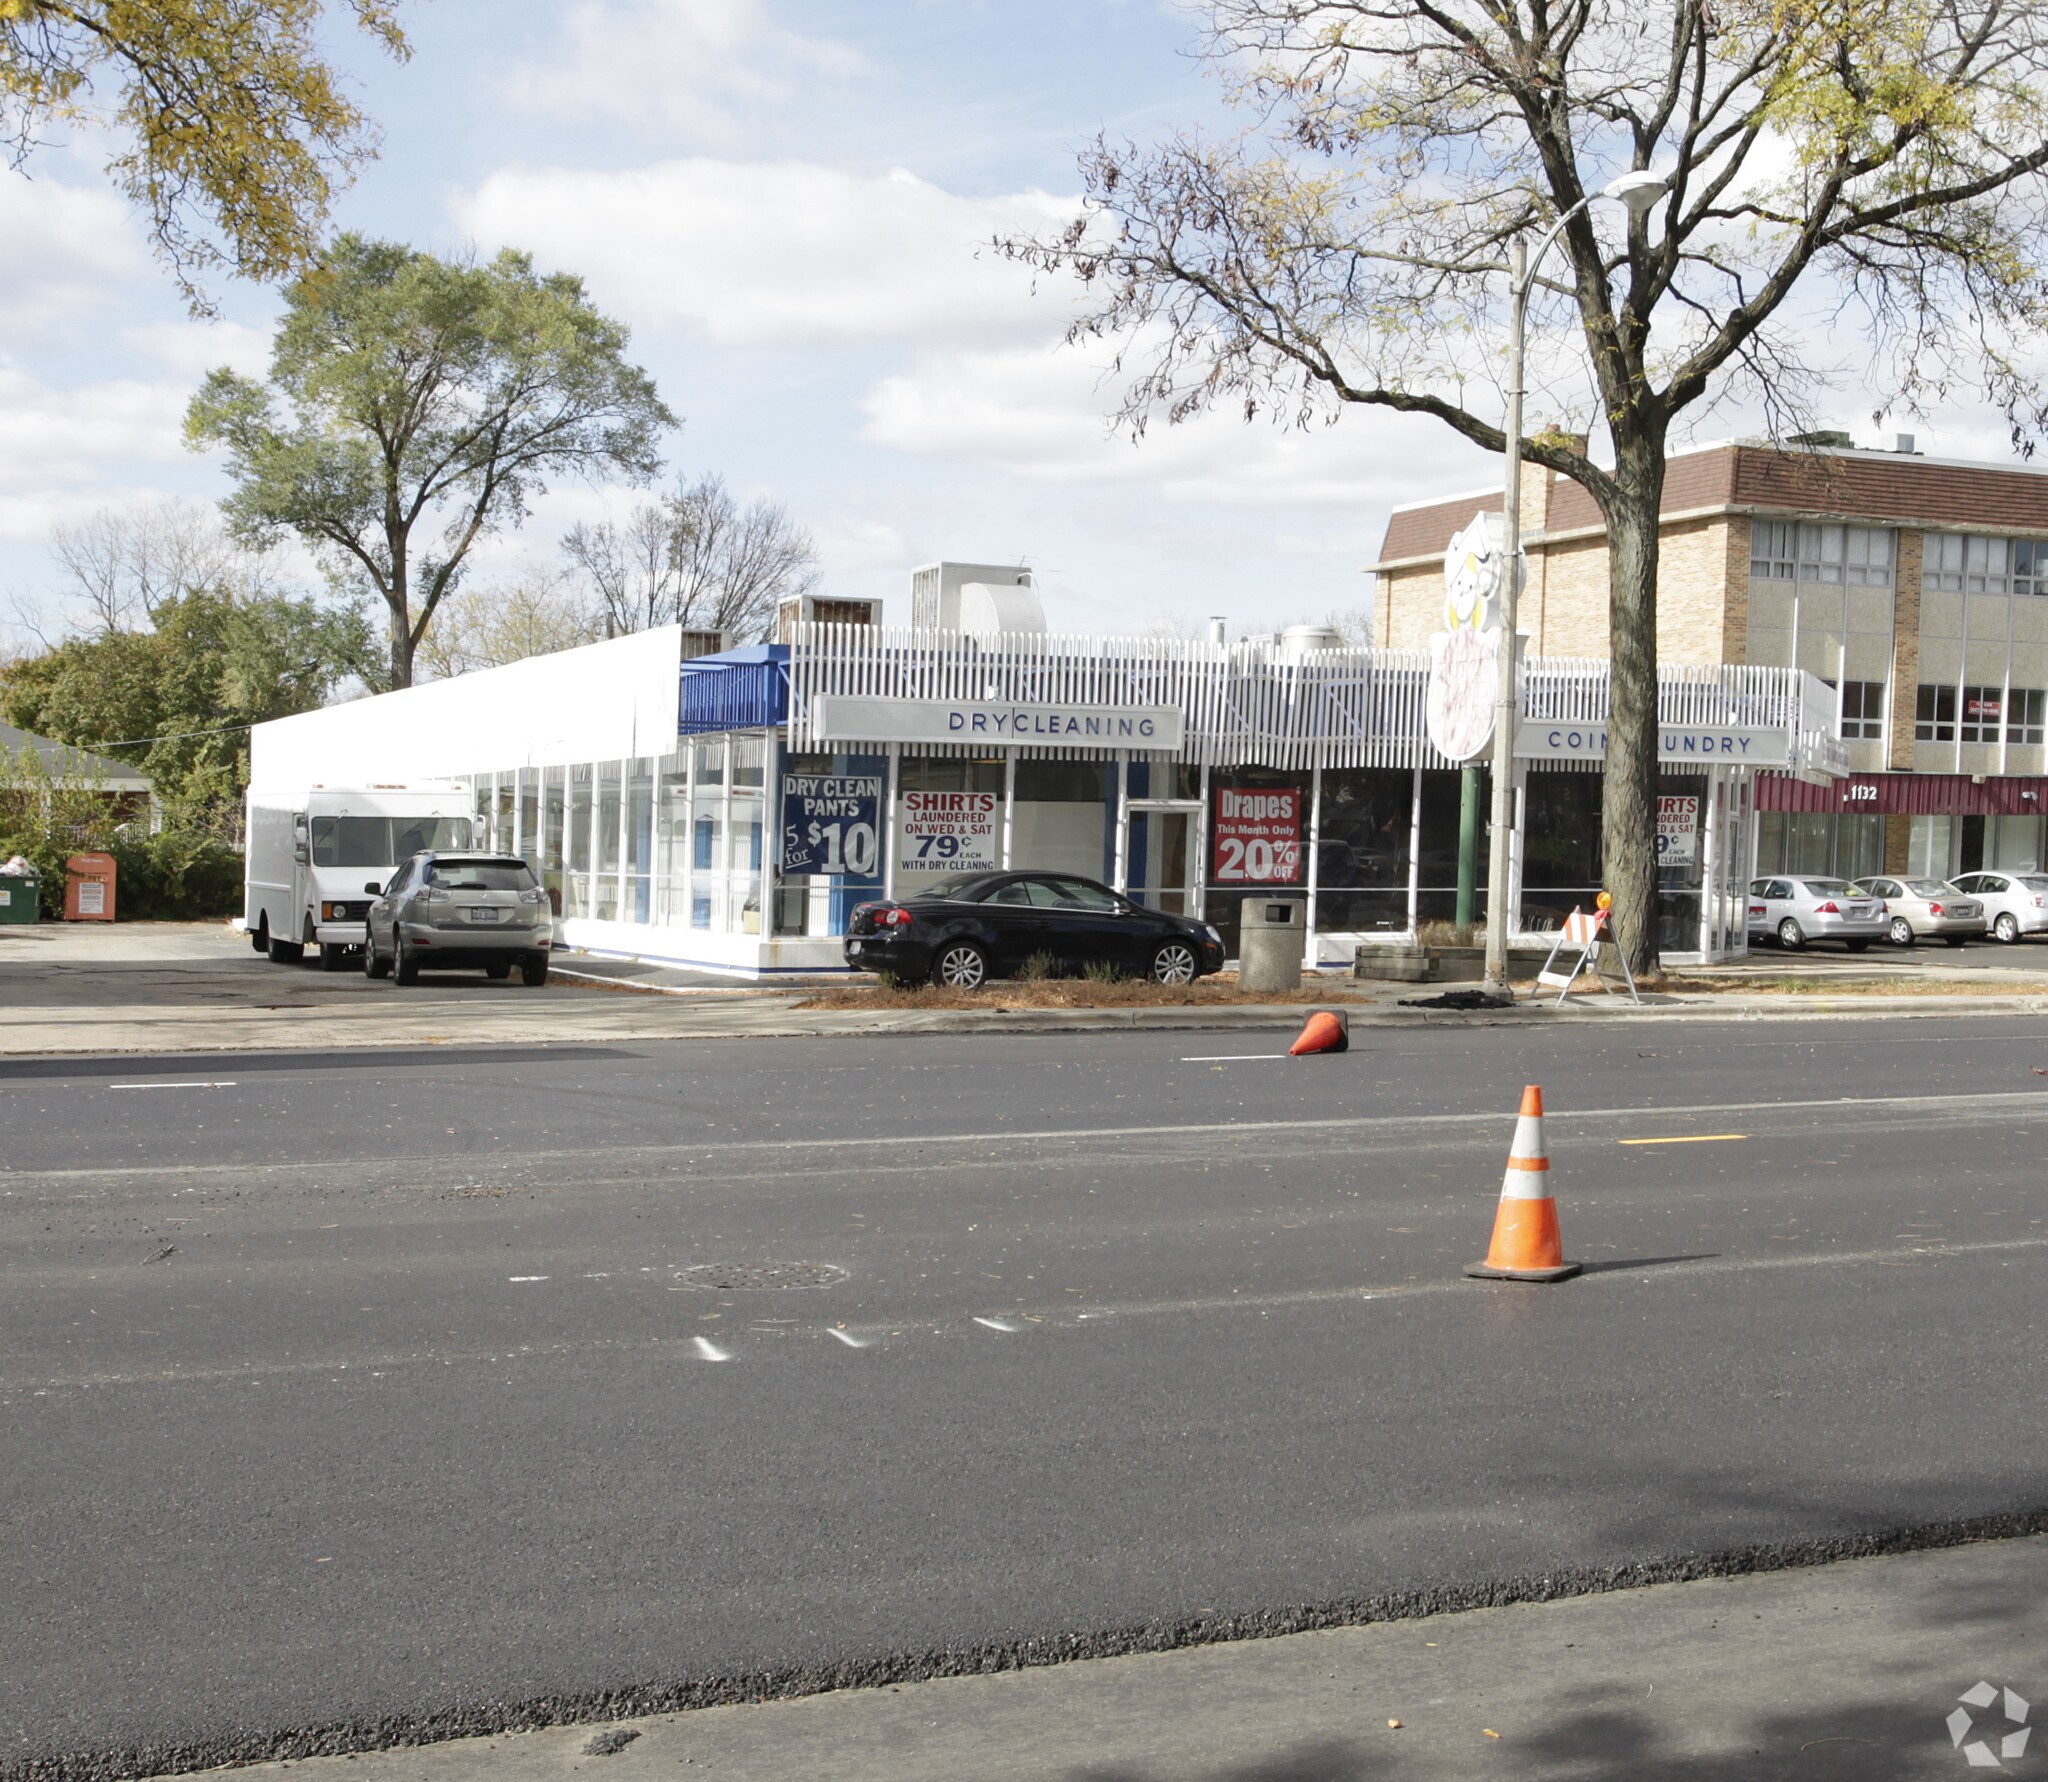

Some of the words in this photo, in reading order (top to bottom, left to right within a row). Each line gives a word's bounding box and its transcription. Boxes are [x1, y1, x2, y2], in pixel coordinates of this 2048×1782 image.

[1665, 735, 1751, 753] UNDRY
[785, 777, 819, 797] DRY
[823, 779, 878, 797] CLEAN
[1851, 785, 1877, 800] 1132
[804, 798, 860, 817] PANTS
[906, 793, 994, 812] SHIRTS
[1222, 790, 1293, 821] Drapes
[1657, 797, 1697, 813] IRTS
[913, 812, 986, 823] LAUNDERED
[1657, 814, 1690, 823] DERED
[786, 823, 799, 847] 5
[905, 823, 923, 834] ON
[927, 824, 955, 834] WED
[958, 825, 966, 835] &
[970, 824, 993, 835] SAT
[1217, 824, 1236, 834] This
[1238, 824, 1269, 835] Month
[1272, 825, 1295, 836] Only
[1657, 825, 1667, 833] ED
[1669, 825, 1676, 833] &
[1678, 824, 1695, 833] SAT
[807, 819, 875, 873] $10
[785, 847, 808, 865] for
[1660, 856, 1695, 865] CLEANING
[902, 860, 926, 870] WITH
[928, 860, 947, 870] DRY
[949, 861, 994, 871] CLEANING
[1273, 865, 1295, 878] OFF
